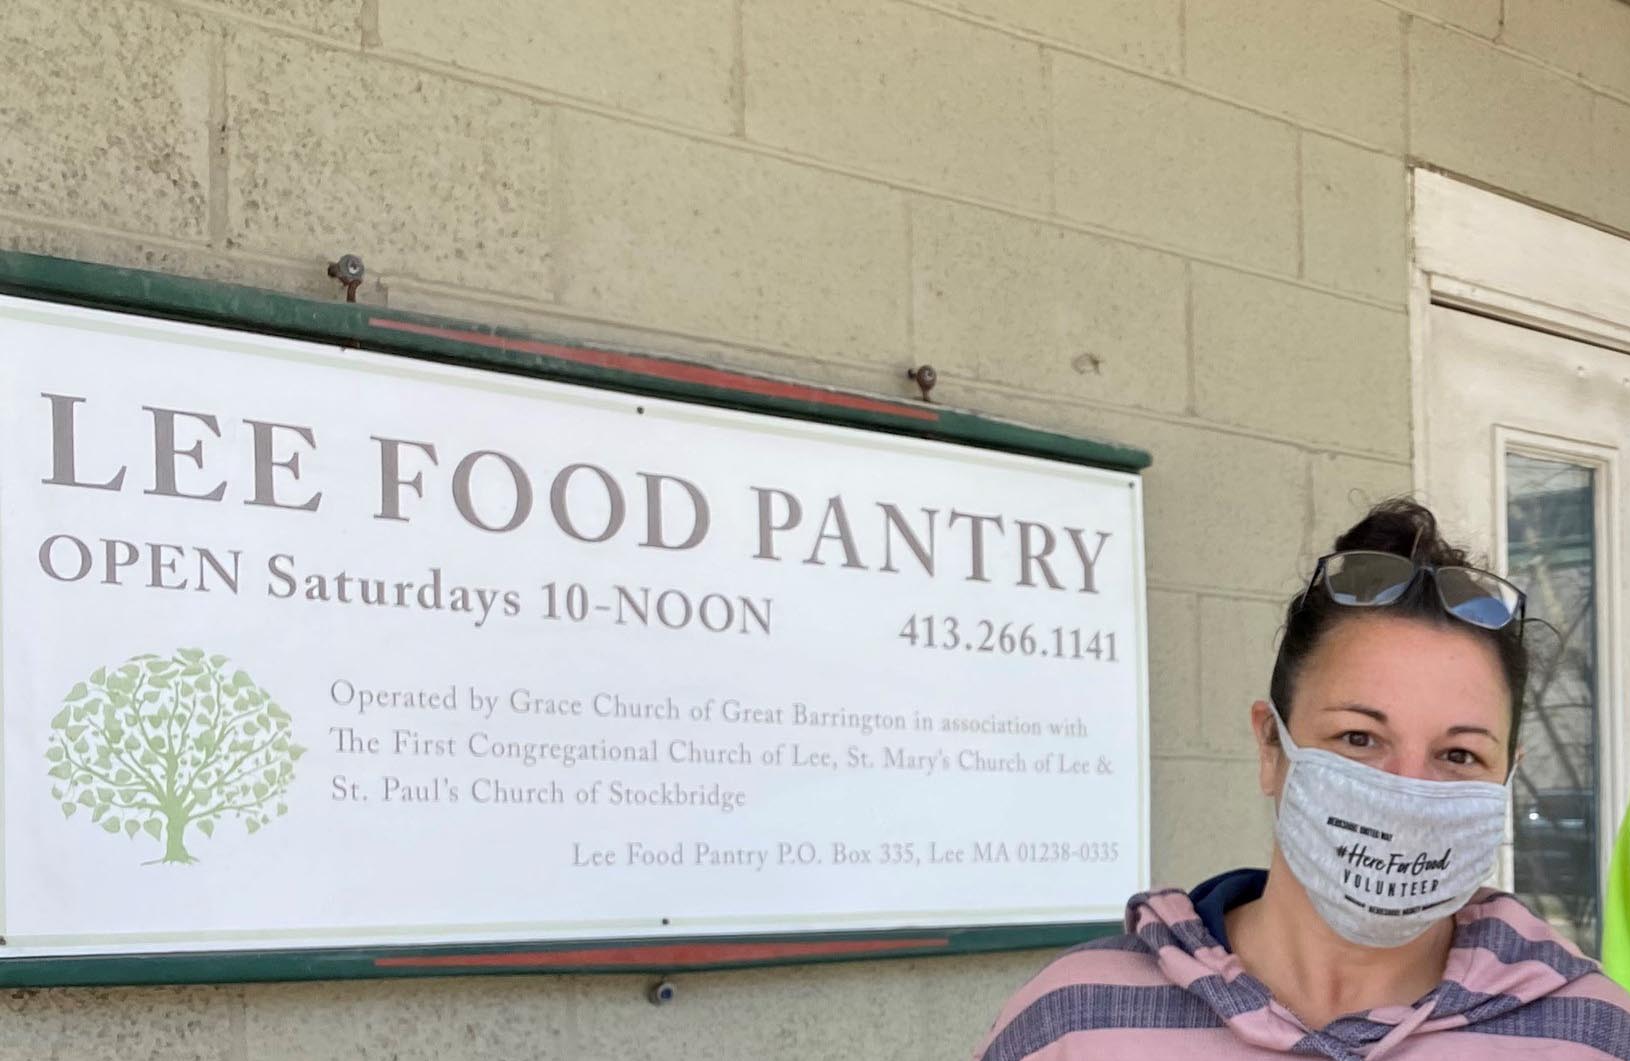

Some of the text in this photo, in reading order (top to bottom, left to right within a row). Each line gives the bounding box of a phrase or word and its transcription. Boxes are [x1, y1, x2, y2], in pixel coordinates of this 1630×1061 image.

[41, 392, 1112, 594] LEE FOOD PANTRY
[39, 534, 772, 635] OPEN Saturdays 10-NOON
[898, 614, 1116, 662] 413.266.1141
[330, 679, 1088, 738] Operated by Grace Church of Great Barrington in association with
[329, 727, 1114, 776] The First Congregational Church of Lee, St. Mary's Church of Lee &
[332, 775, 746, 814] St. Paul's Church of Stockbridge
[572, 840, 1120, 872] Lee Food Pantry P.O. Box 335, Lee MA 01238-0335
[1336, 843, 1451, 876] #HereForGood
[1343, 870, 1440, 898] VOLUNTEER
